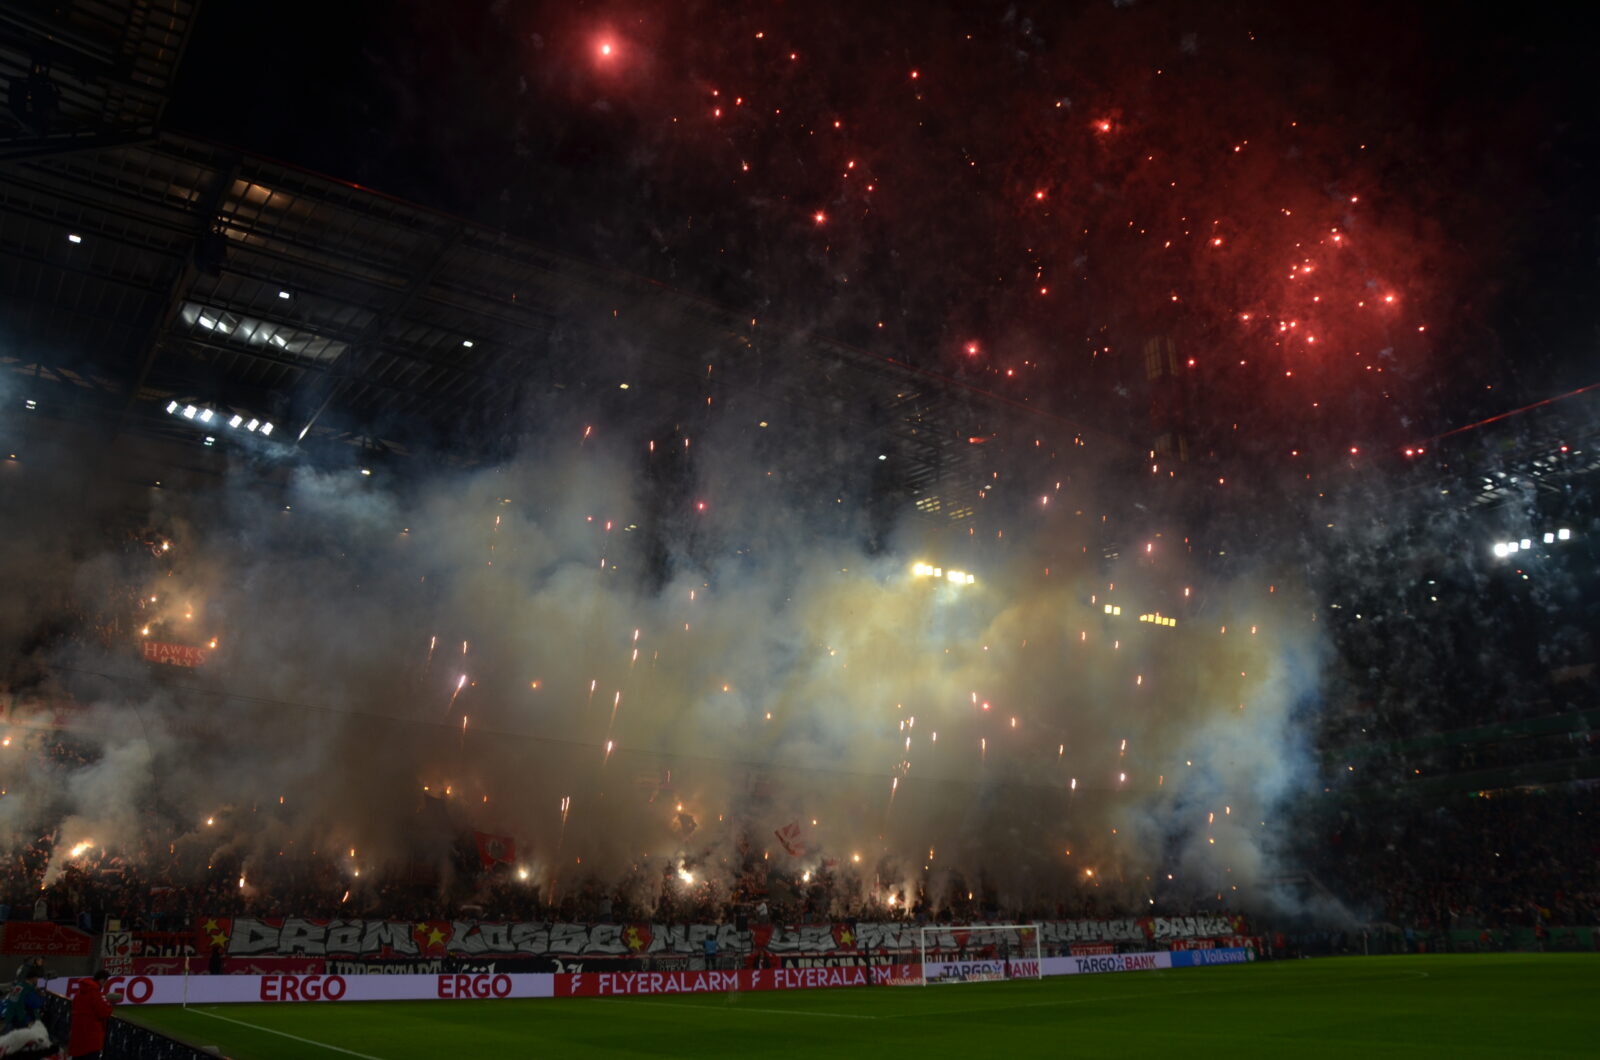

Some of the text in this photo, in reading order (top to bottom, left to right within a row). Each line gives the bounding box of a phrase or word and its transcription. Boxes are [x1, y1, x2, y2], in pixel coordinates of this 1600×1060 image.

[144, 642, 206, 664] HAWKS
[446, 921, 629, 954] LOSSE
[260, 975, 346, 1001] ERGO
[437, 974, 512, 998] ERGO
[599, 971, 739, 994] FLYERALARM
